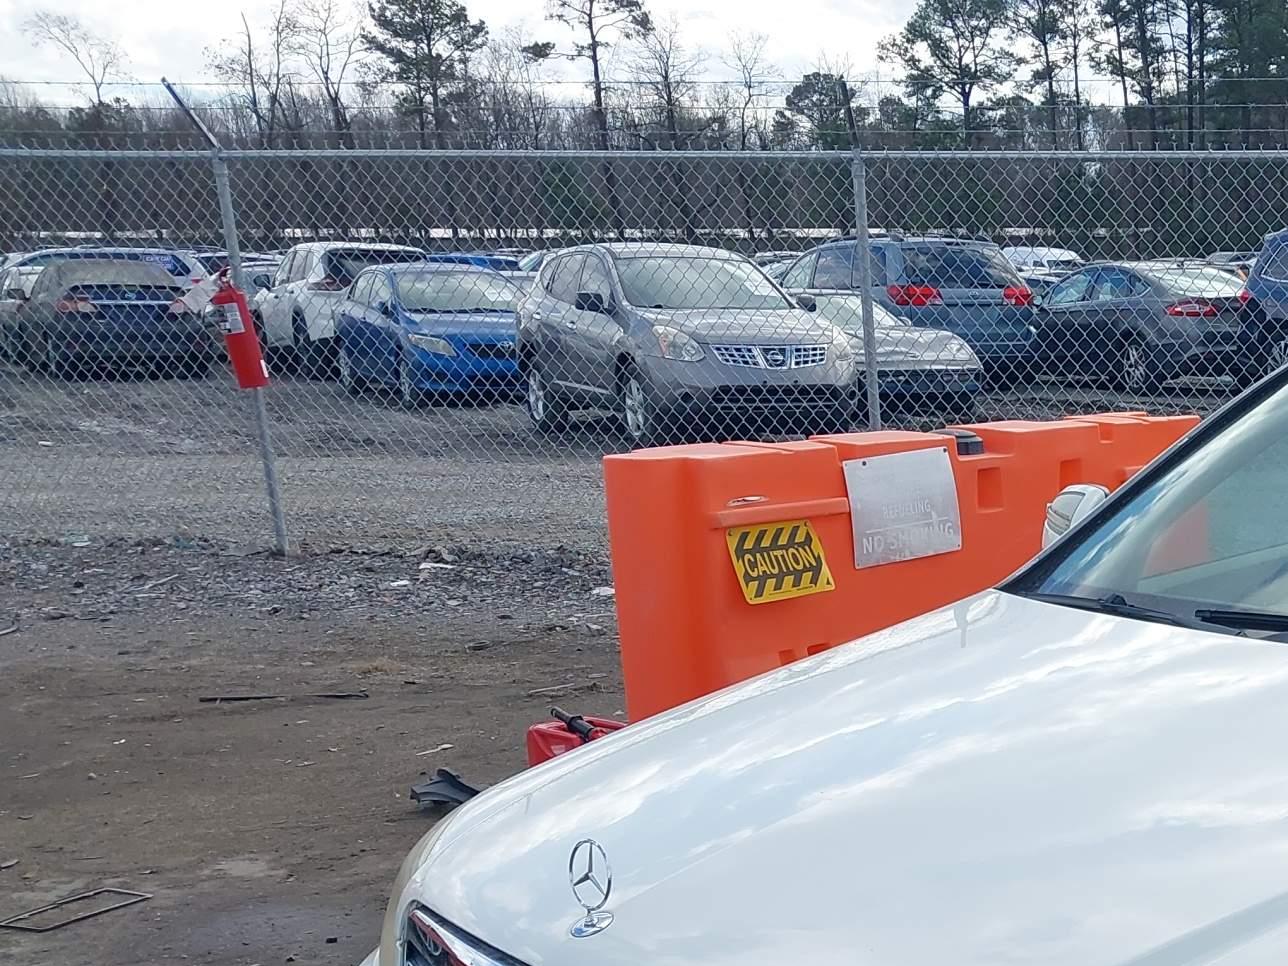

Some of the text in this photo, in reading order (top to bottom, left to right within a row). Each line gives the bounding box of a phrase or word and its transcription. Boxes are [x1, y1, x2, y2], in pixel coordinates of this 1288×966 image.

[882, 498, 931, 520] REFUELING
[862, 535, 885, 555] NO
[889, 522, 954, 551] SMOKING
[743, 544, 818, 578] CAUTION
